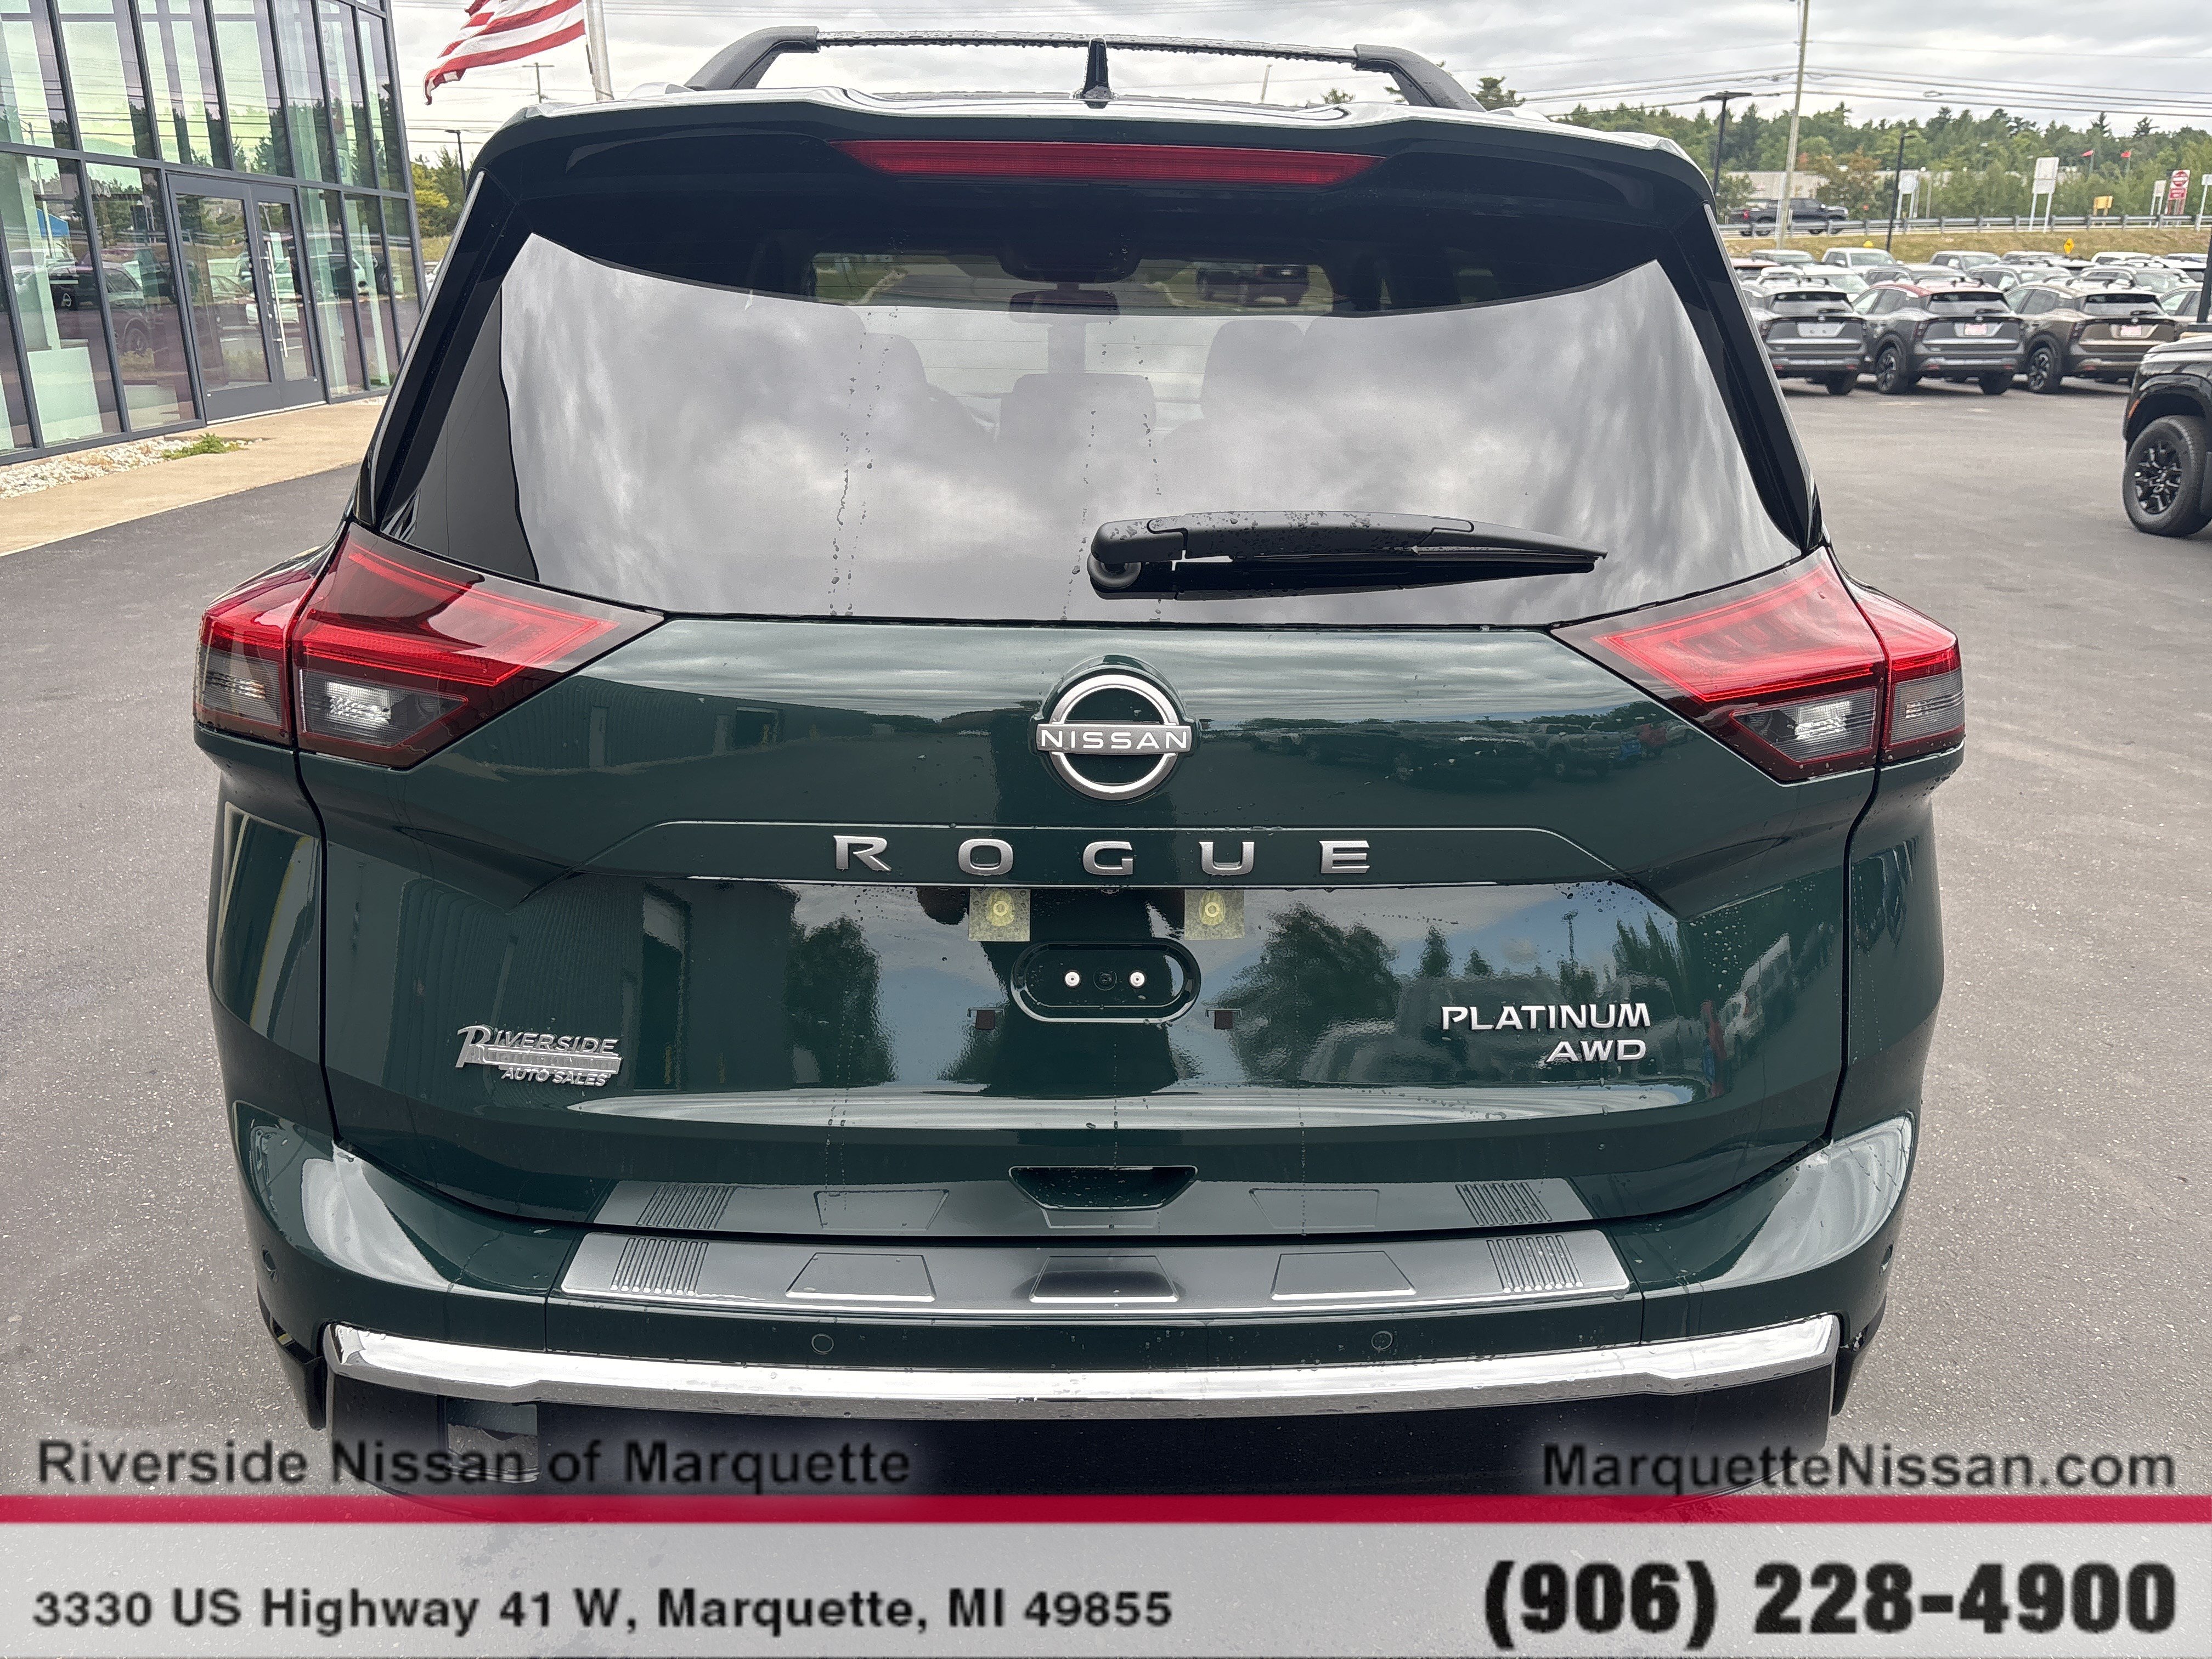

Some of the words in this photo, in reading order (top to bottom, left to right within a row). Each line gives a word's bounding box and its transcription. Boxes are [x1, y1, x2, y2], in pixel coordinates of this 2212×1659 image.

[1041, 729, 1187, 749] NISSAN
[833, 834, 1370, 876] ROGUE
[1440, 1002, 1651, 1030] PLATINUM
[455, 1025, 619, 1068] RIVERSIDE
[1545, 1039, 1646, 1062] AWD
[500, 1068, 550, 1082] AUTO
[552, 1070, 607, 1086] SALES
